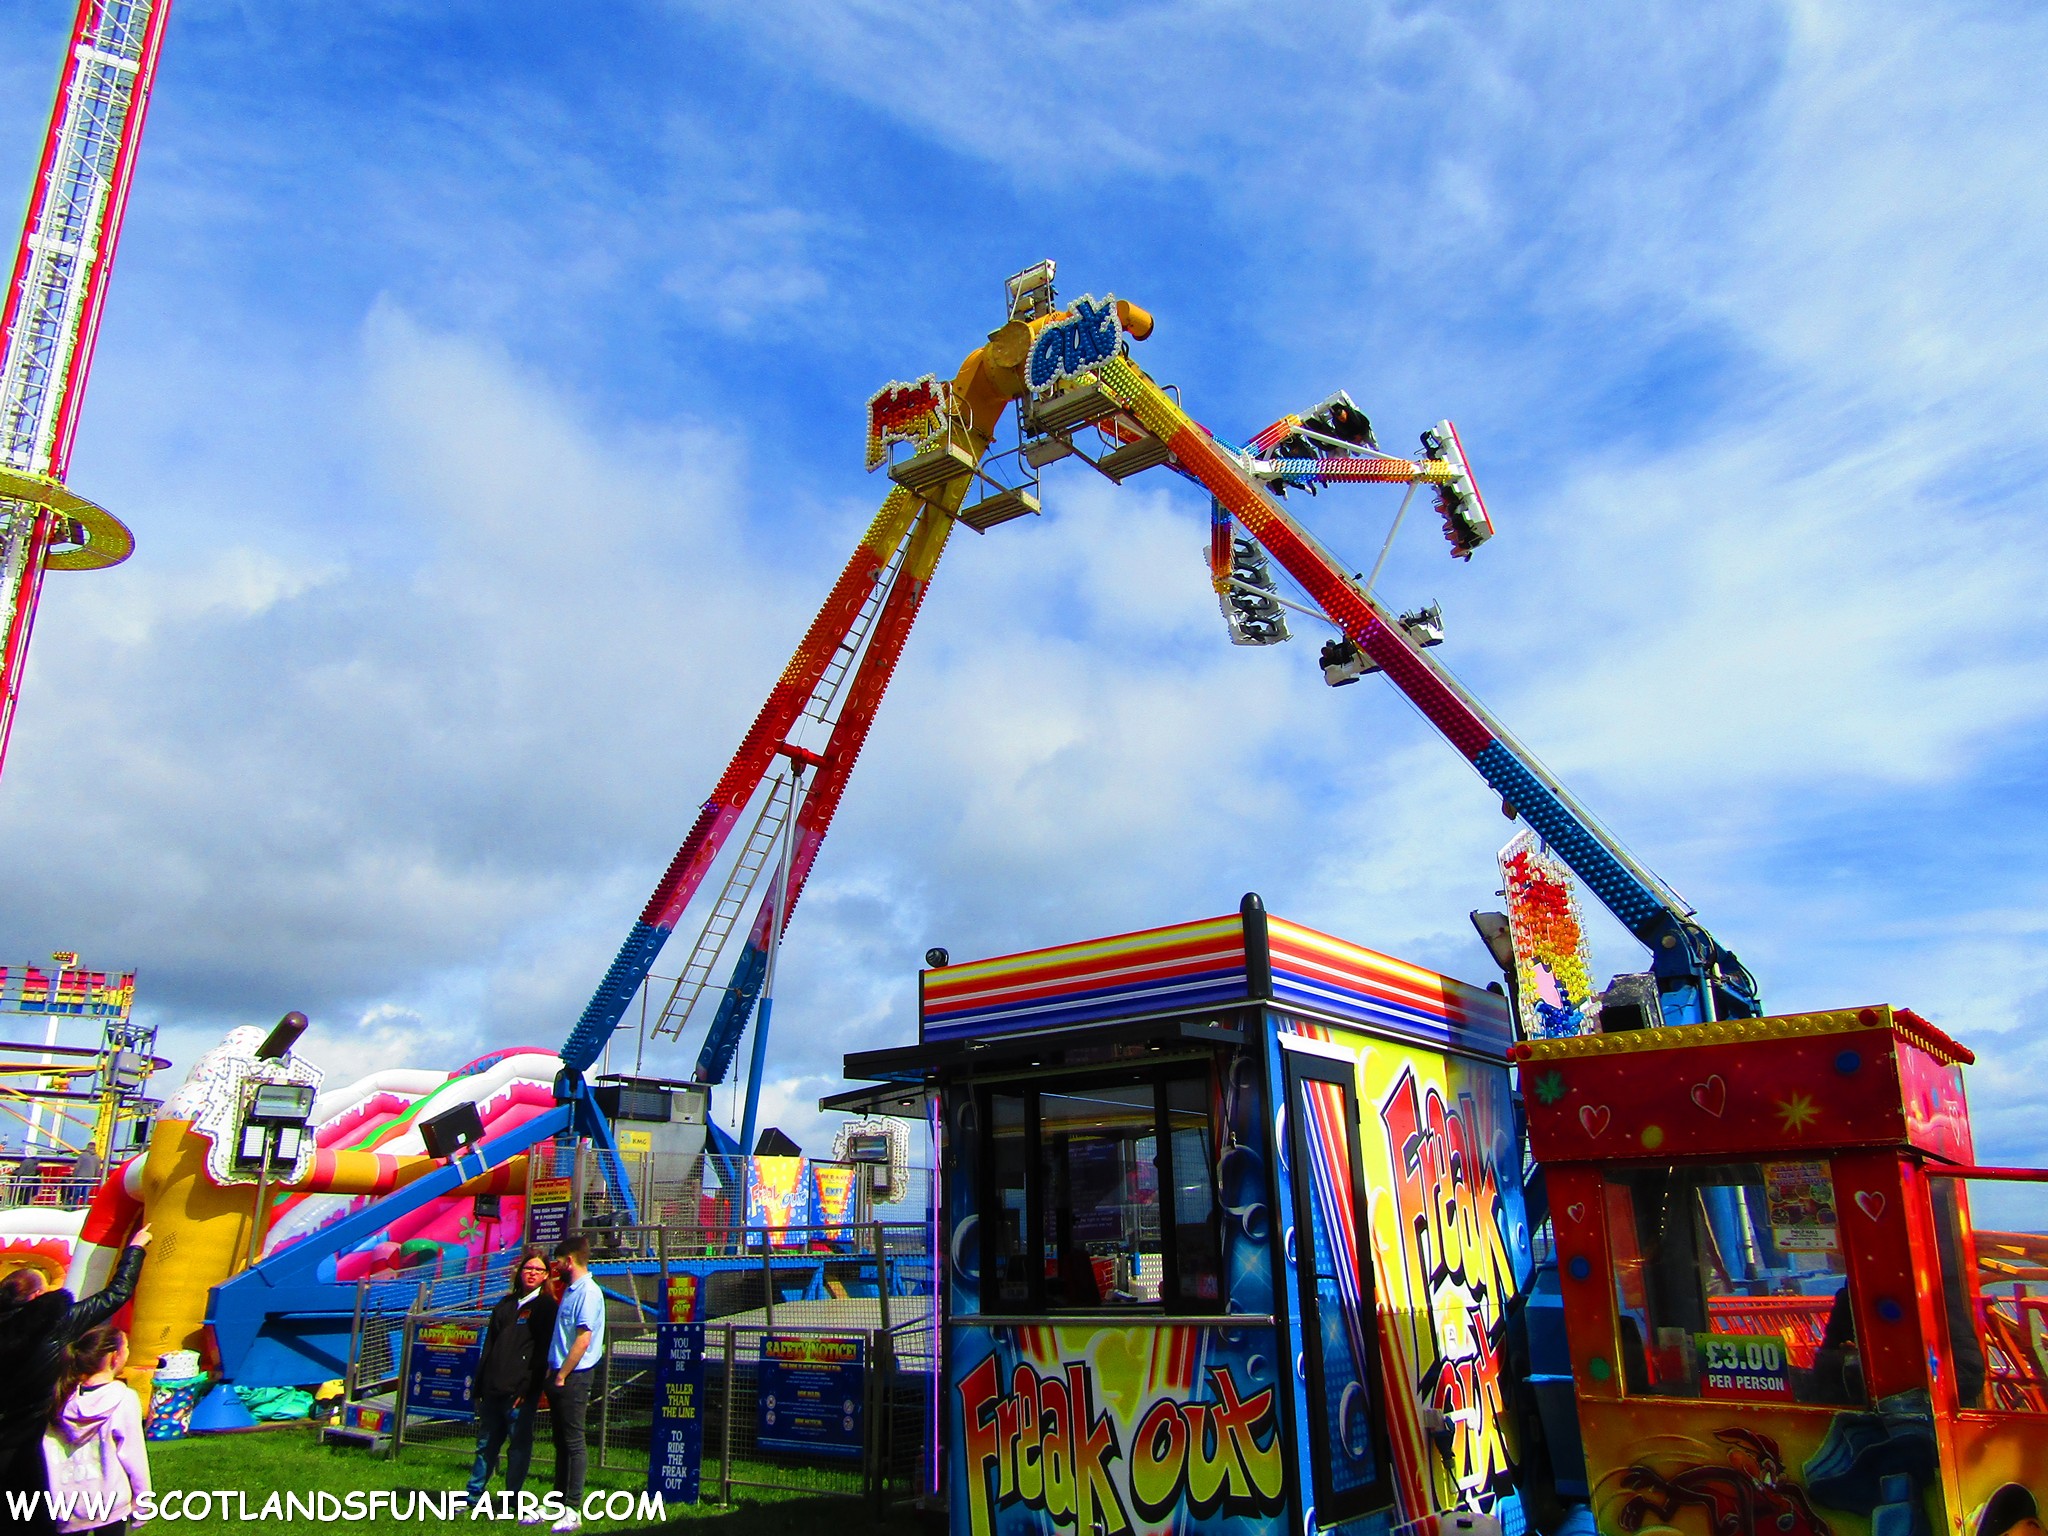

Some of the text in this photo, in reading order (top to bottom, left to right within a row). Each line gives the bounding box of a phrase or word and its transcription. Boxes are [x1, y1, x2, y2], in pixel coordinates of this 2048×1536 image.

[418, 1327, 445, 1342] SAFETY
[673, 1337, 689, 1348] YOU
[670, 1349, 692, 1360] MUST
[765, 1341, 857, 1361] SAFETY NOTICE!
[1705, 1341, 1780, 1371] £3.00
[675, 1360, 686, 1371] BE
[665, 1383, 694, 1395] TALLER
[1708, 1374, 1785, 1392] PER PERSON
[668, 1394, 690, 1406] THAN
[662, 1406, 696, 1419] THE LINE
[671, 1430, 683, 1442] TO
[667, 1441, 686, 1454] RIDE
[958, 1350, 1285, 1536] Freak out
[667, 1454, 683, 1466] THE
[661, 1465, 688, 1478] FREAK
[665, 1477, 683, 1490] OUT
